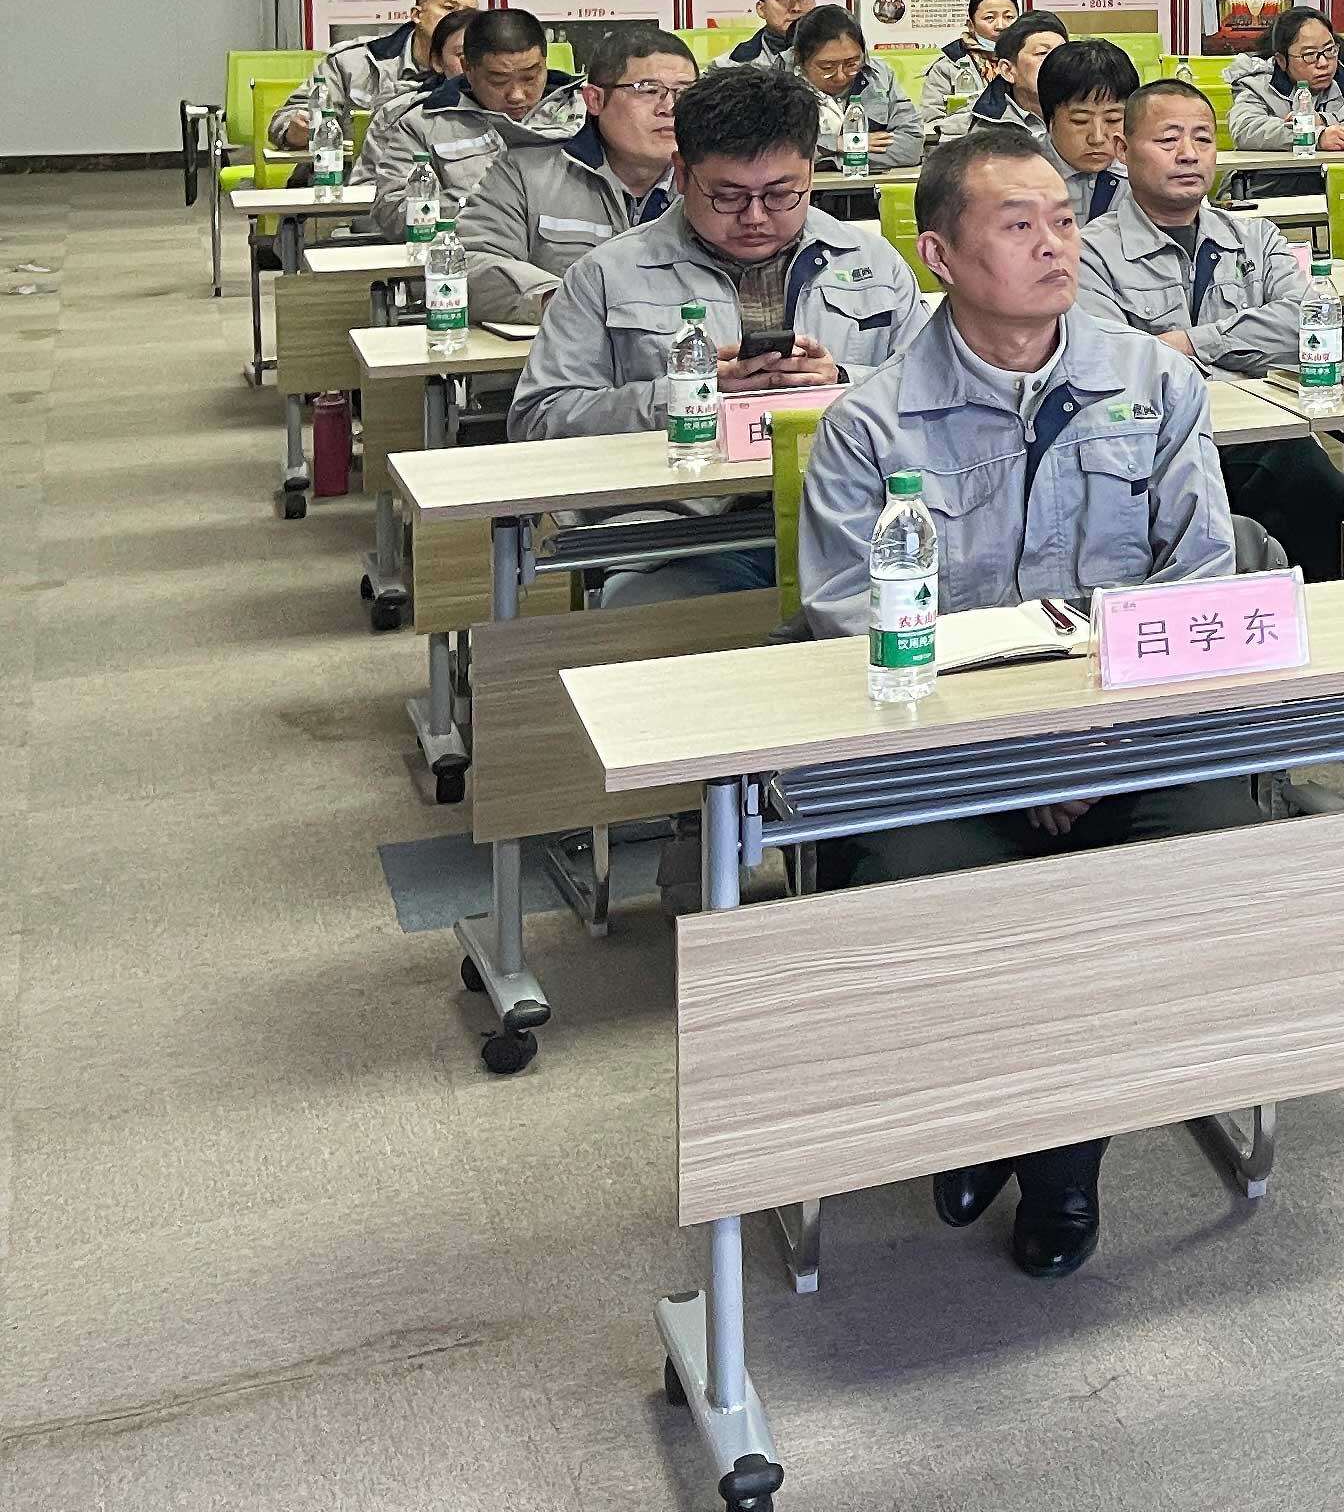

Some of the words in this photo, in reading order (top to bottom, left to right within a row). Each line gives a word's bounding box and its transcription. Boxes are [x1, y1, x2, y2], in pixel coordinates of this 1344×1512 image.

[577, 8, 607, 18] 1979
[1136, 606, 1281, 660] 吕学东
